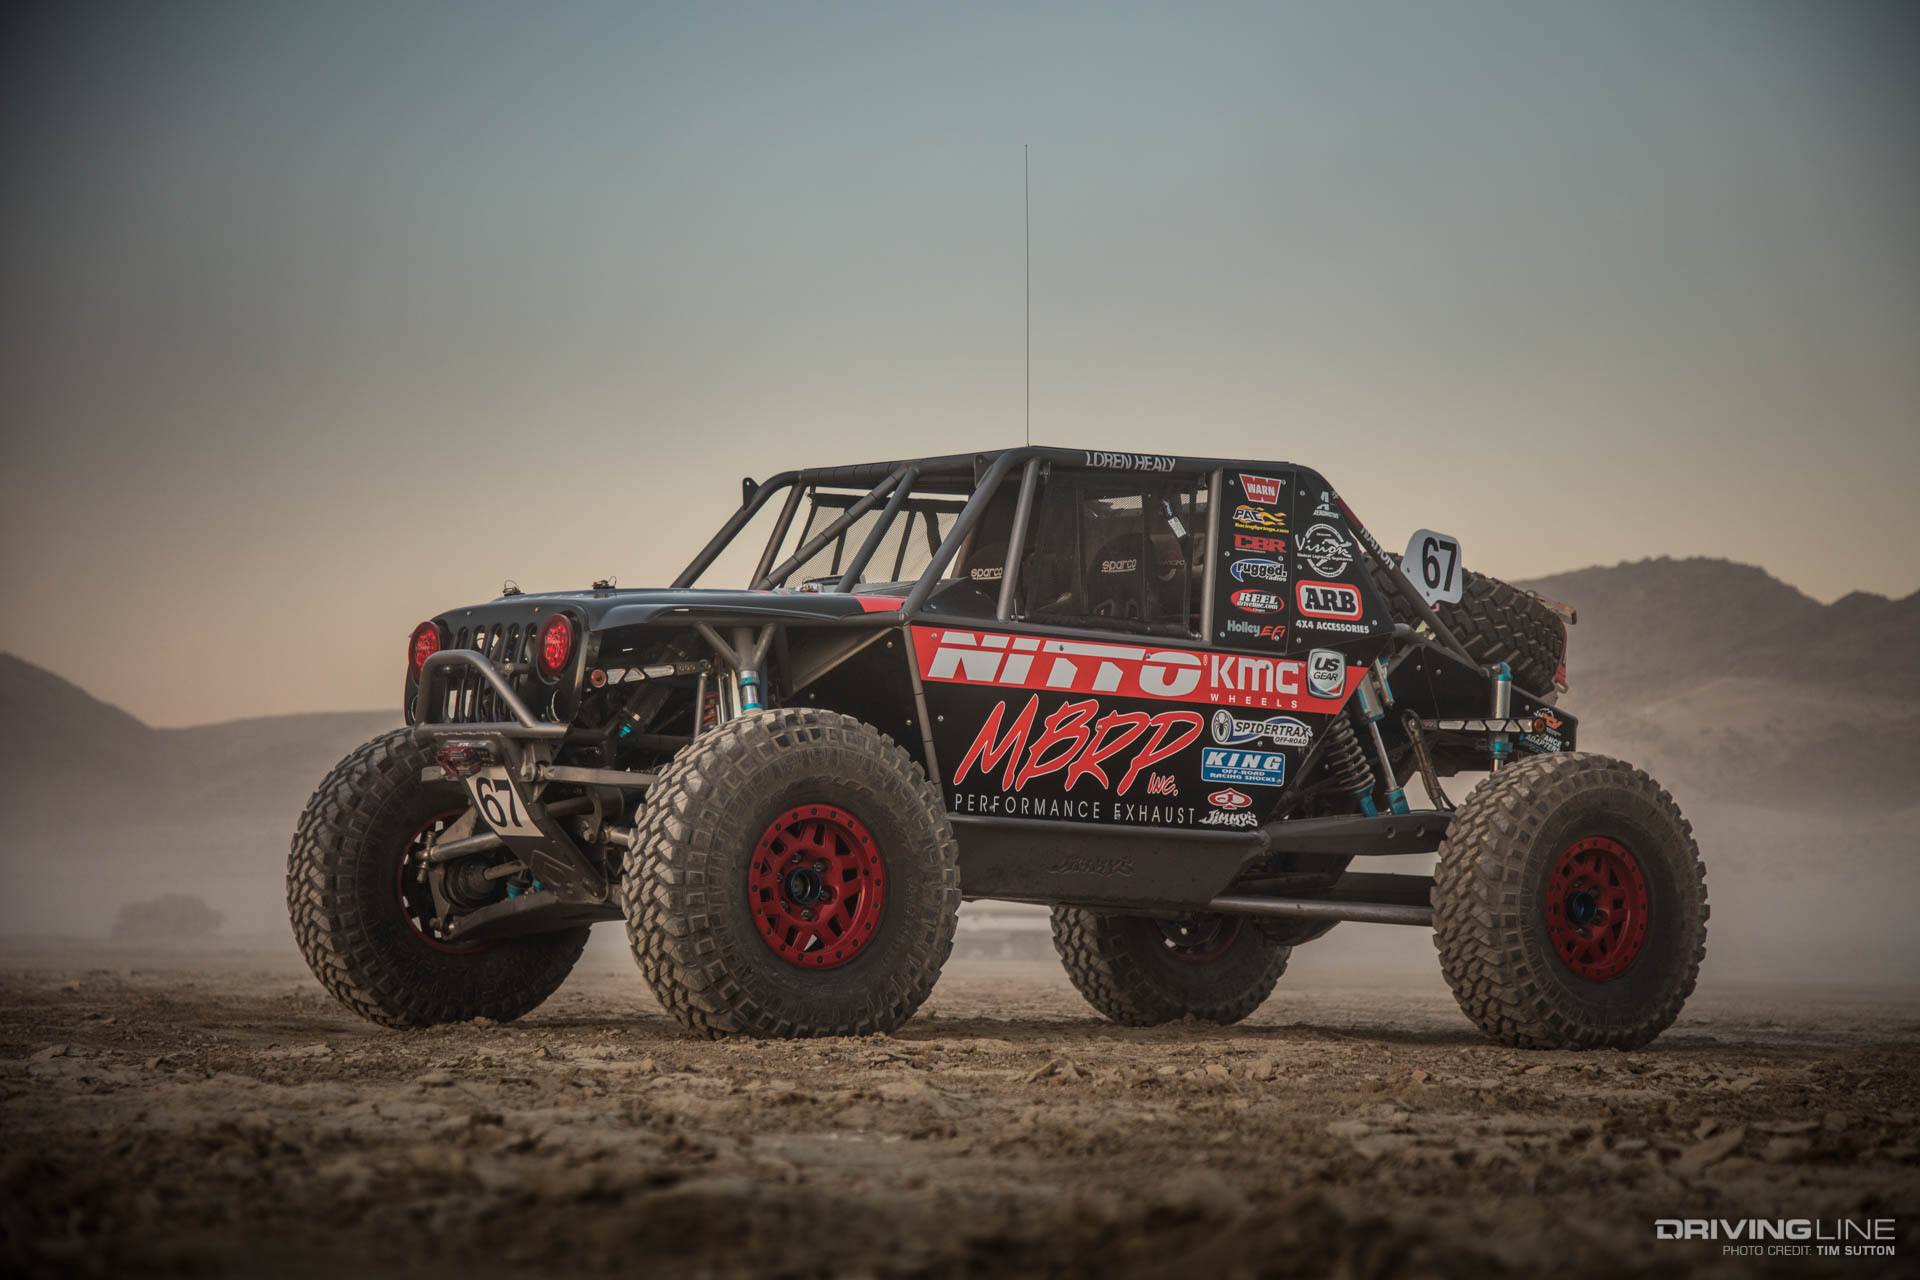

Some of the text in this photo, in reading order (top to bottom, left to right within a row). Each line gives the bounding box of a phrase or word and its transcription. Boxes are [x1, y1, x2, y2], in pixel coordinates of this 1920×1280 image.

[1085, 451, 1176, 472] LOREN HEALY
[1247, 483, 1276, 496] WARN
[970, 566, 1003, 578] sparco
[1102, 559, 1137, 571] sparco
[1422, 536, 1457, 592] 67
[1239, 592, 1278, 604] REEL
[1304, 587, 1357, 612] ARB
[1227, 620, 1260, 637] Holley
[1316, 621, 1370, 633] ACCESSORIES
[927, 631, 1202, 697] NITTO
[1314, 657, 1340, 672] US
[1313, 671, 1338, 681] GEAR
[1210, 693, 1298, 709] WHEELS
[1234, 722, 1309, 738] SPIDERTRAX
[953, 693, 1204, 797] MBRP
[1274, 736, 1307, 745] OFF-ROAD
[1206, 751, 1282, 770] KING
[1210, 772, 1276, 783] RACING SHOCKS
[1222, 768, 1265, 777] OFF-ROAD
[475, 776, 524, 829] 67
[954, 793, 1196, 826] PERFORMANCE EXHAUST
